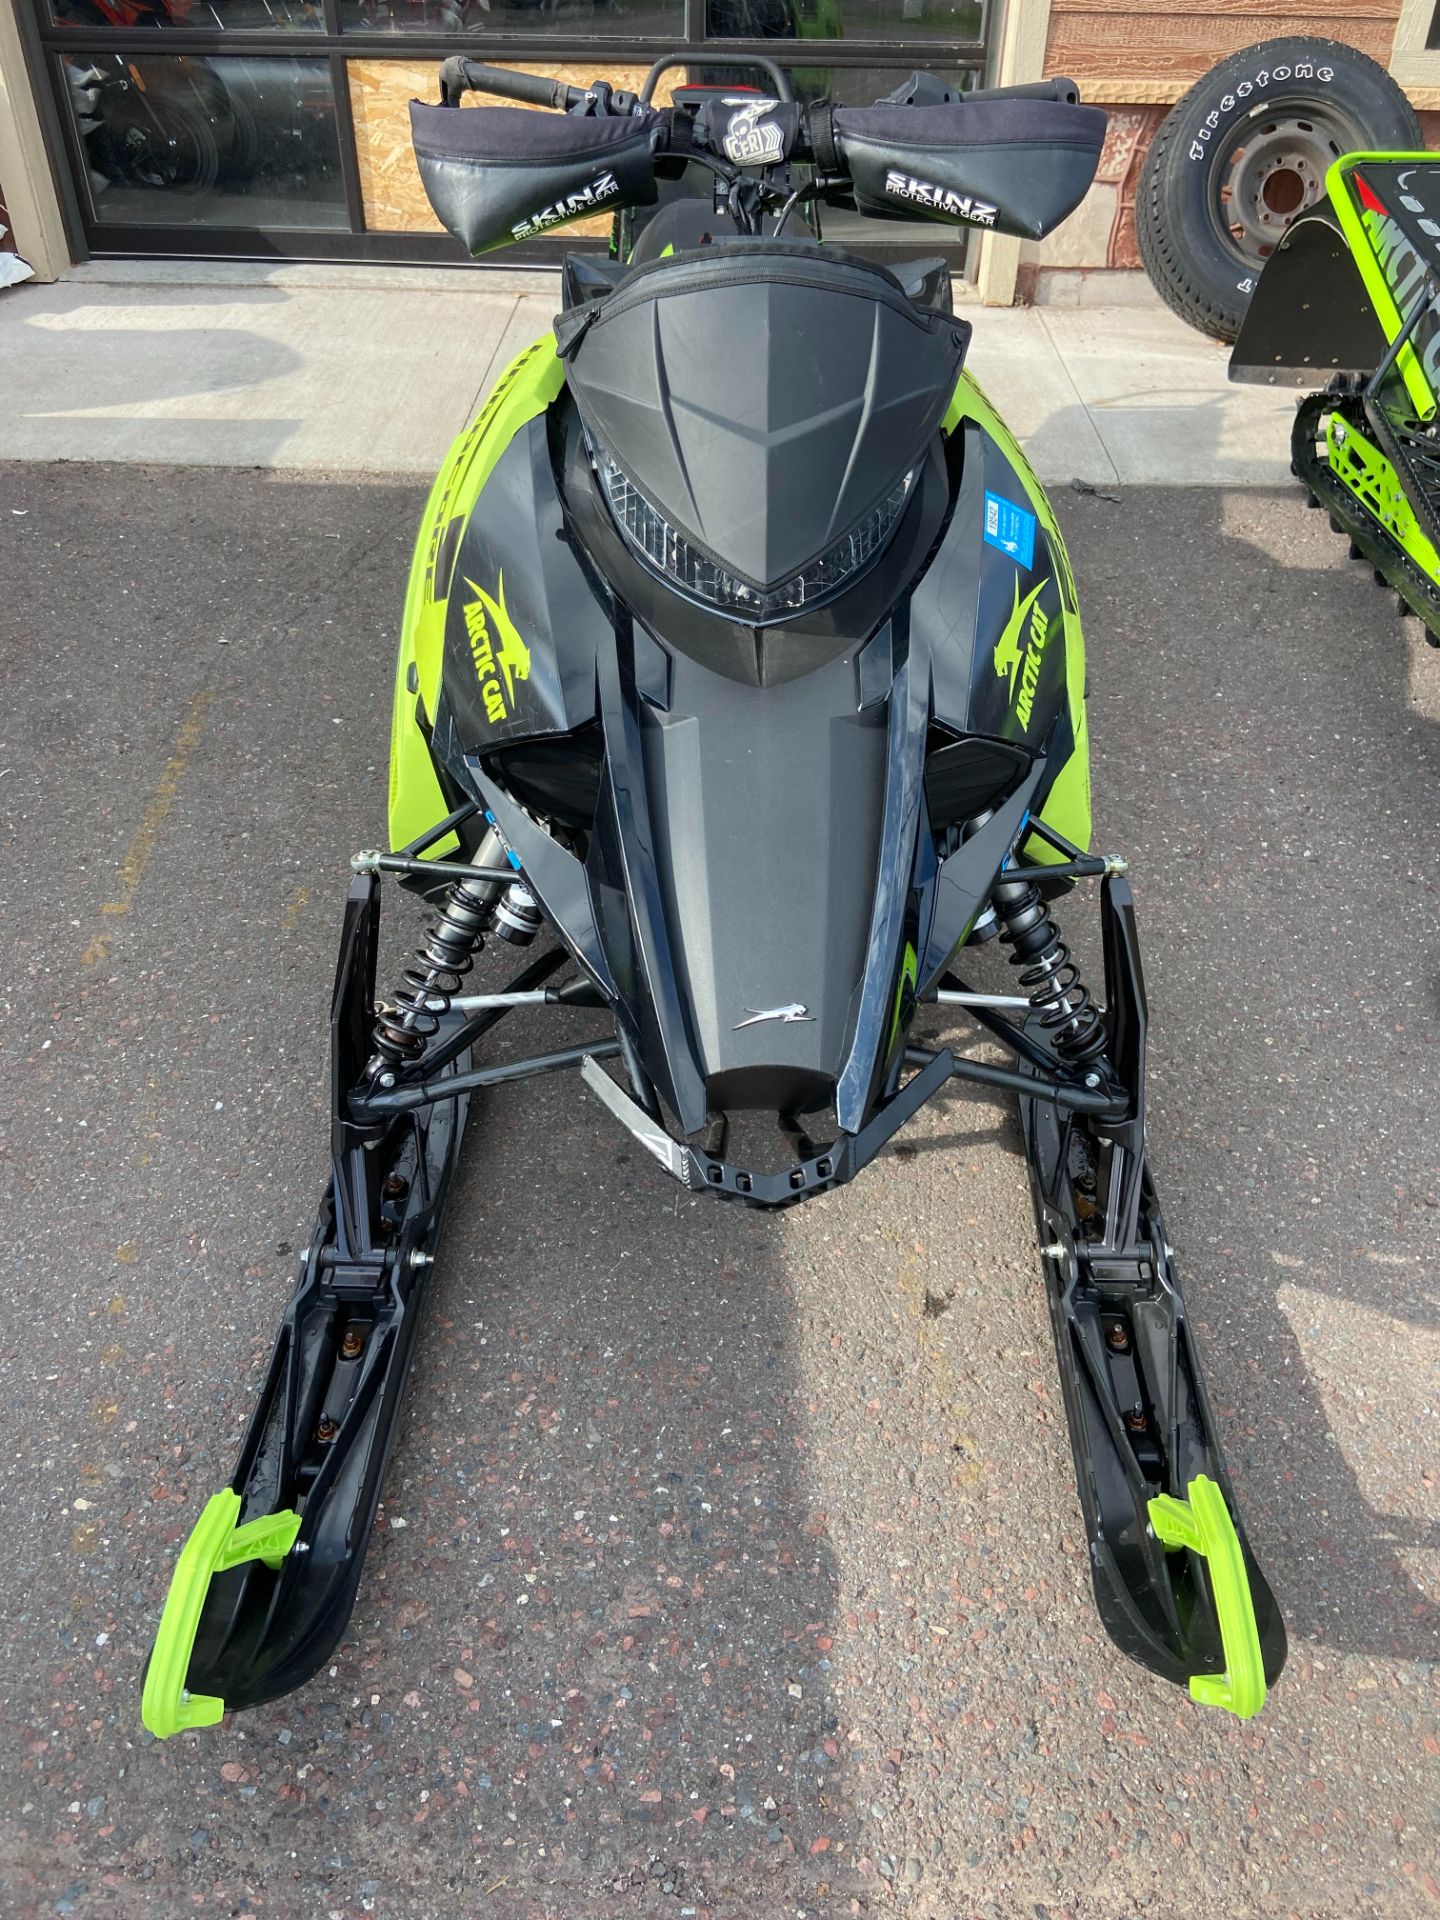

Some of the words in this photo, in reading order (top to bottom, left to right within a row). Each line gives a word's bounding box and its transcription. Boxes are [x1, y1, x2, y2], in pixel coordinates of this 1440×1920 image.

[1188, 64, 1335, 161] Firestone
[511, 173, 617, 234] SKINZ
[513, 203, 585, 242] PROTECTIVE
[586, 182, 620, 206] GEAR
[885, 182, 958, 214] PROTECTIVE
[959, 209, 994, 227] GEAR
[887, 172, 998, 221] SKINZ
[1029, 600, 1050, 650] CAT
[462, 600, 495, 682] ARCTIC
[481, 678, 507, 724] CAT
[1016, 642, 1043, 734] ARCTIC
